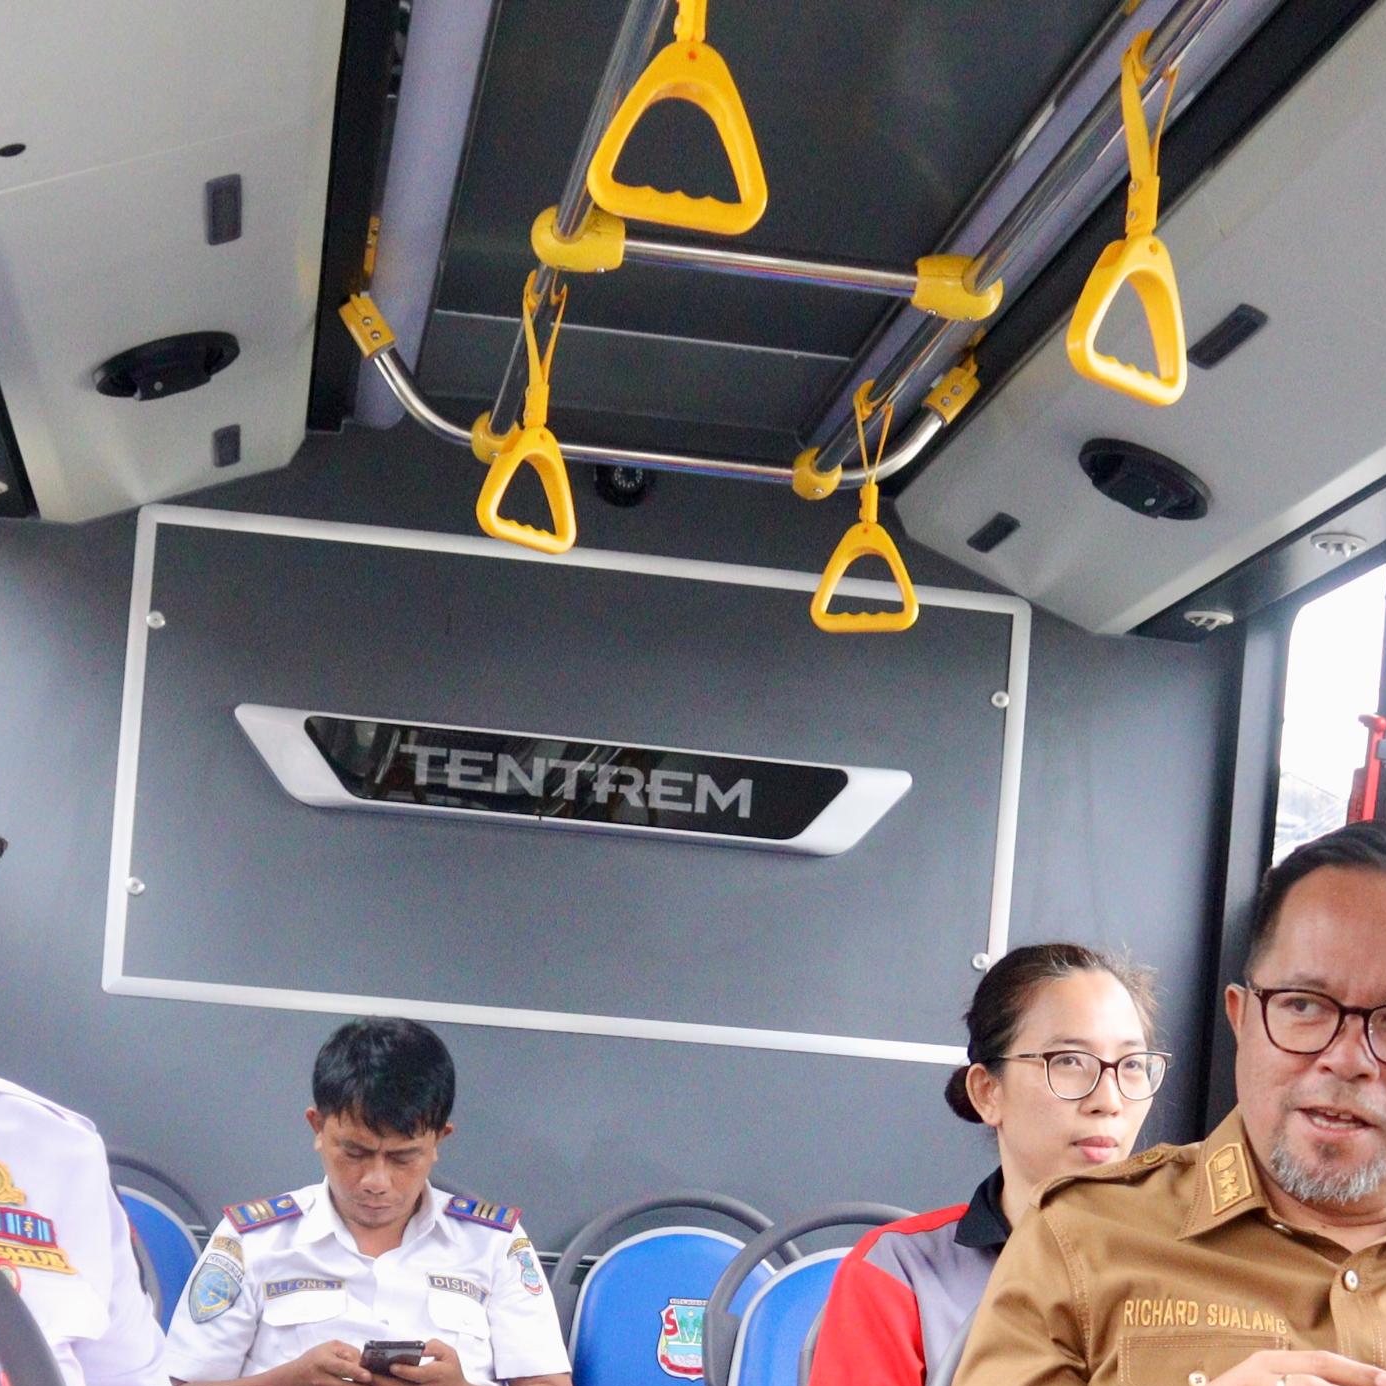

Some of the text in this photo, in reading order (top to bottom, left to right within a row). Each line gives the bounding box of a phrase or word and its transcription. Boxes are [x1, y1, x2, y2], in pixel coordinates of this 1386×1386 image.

[400, 743, 753, 818] TENTREM
[1124, 1299, 1287, 1334] RICHARD SUALANG
